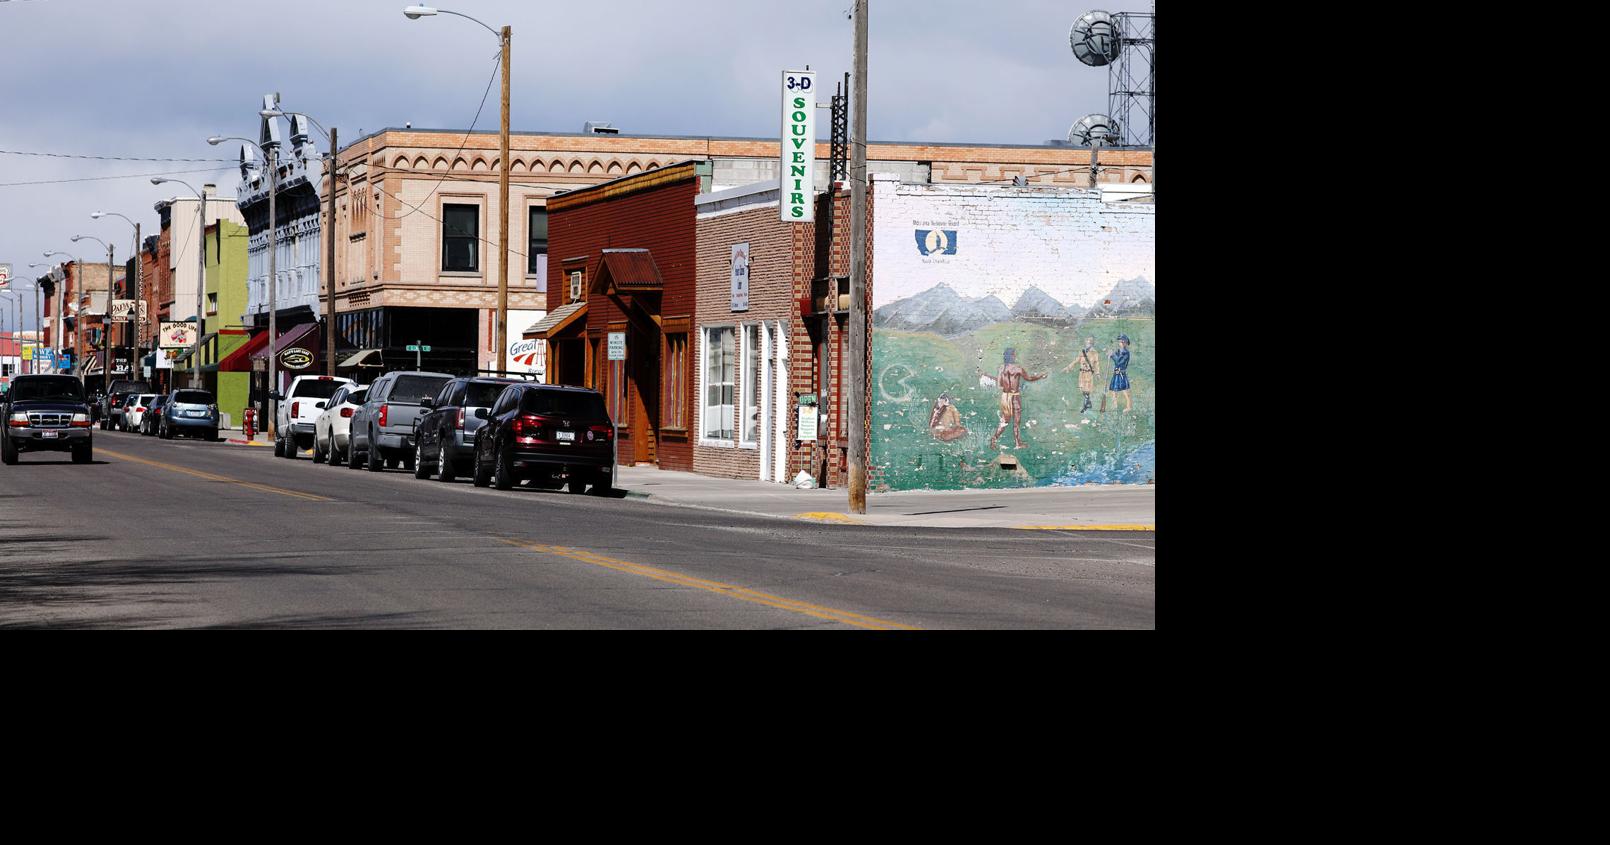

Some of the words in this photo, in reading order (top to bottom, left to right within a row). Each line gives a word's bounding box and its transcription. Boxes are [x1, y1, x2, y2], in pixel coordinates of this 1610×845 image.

[787, 76, 811, 90] 3-D
[790, 97, 807, 218] SOUVENIRS
[162, 325, 172, 333] THE
[172, 321, 188, 329] GOOD
[510, 338, 537, 356] Great
